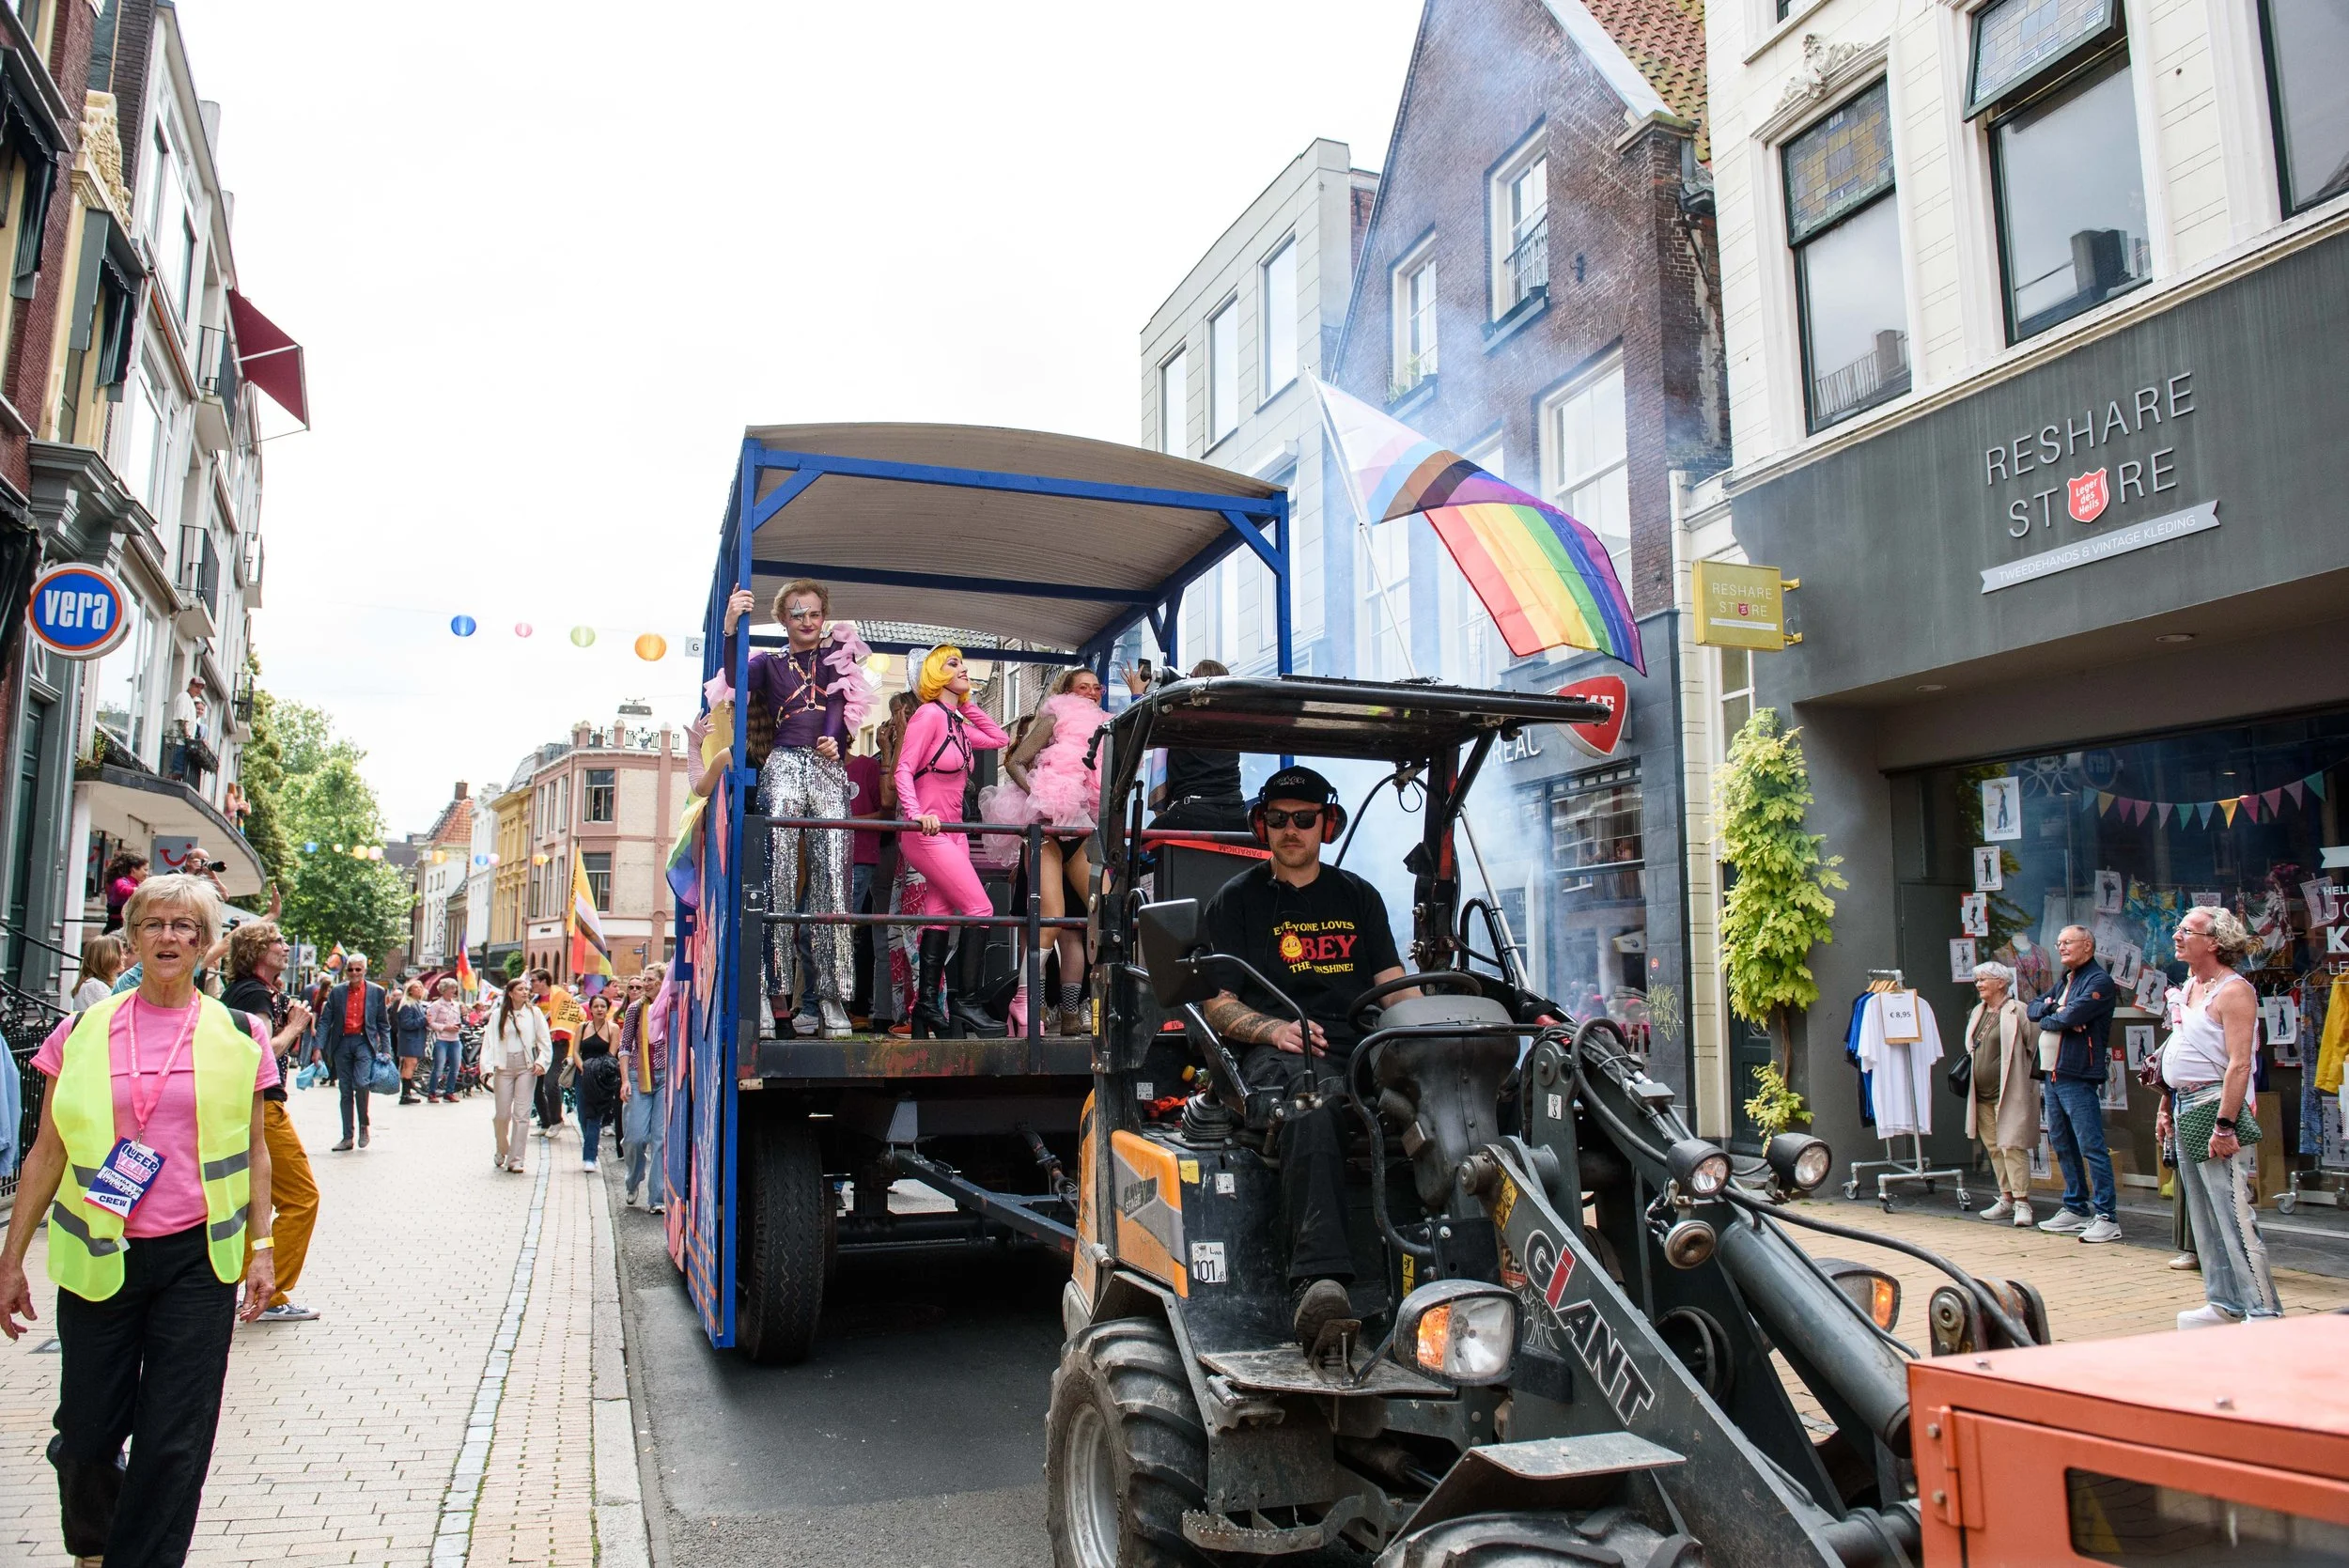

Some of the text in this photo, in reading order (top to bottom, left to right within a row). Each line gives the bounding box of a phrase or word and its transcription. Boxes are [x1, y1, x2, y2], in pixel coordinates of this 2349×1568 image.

[1985, 371, 2195, 486] RESHARE
[2075, 478, 2098, 497] Leger
[2080, 491, 2095, 505] des
[2078, 499, 2100, 516] Heils
[1999, 514, 2197, 582] TWEEDEHANDS & VINTAGE KLEDING
[1712, 582, 1773, 600] RESHARE
[44, 589, 109, 630] vera
[692, 643, 700, 651] G
[1218, 844, 1264, 858] PARADIGM
[2323, 886, 2349, 896] HEL
[1321, 921, 1355, 930] LOVES
[1289, 960, 1313, 973] THE
[1895, 1011, 1911, 1019] 8,95
[99, 1195, 127, 1207] CREW
[1194, 1260, 1217, 1281] 101
